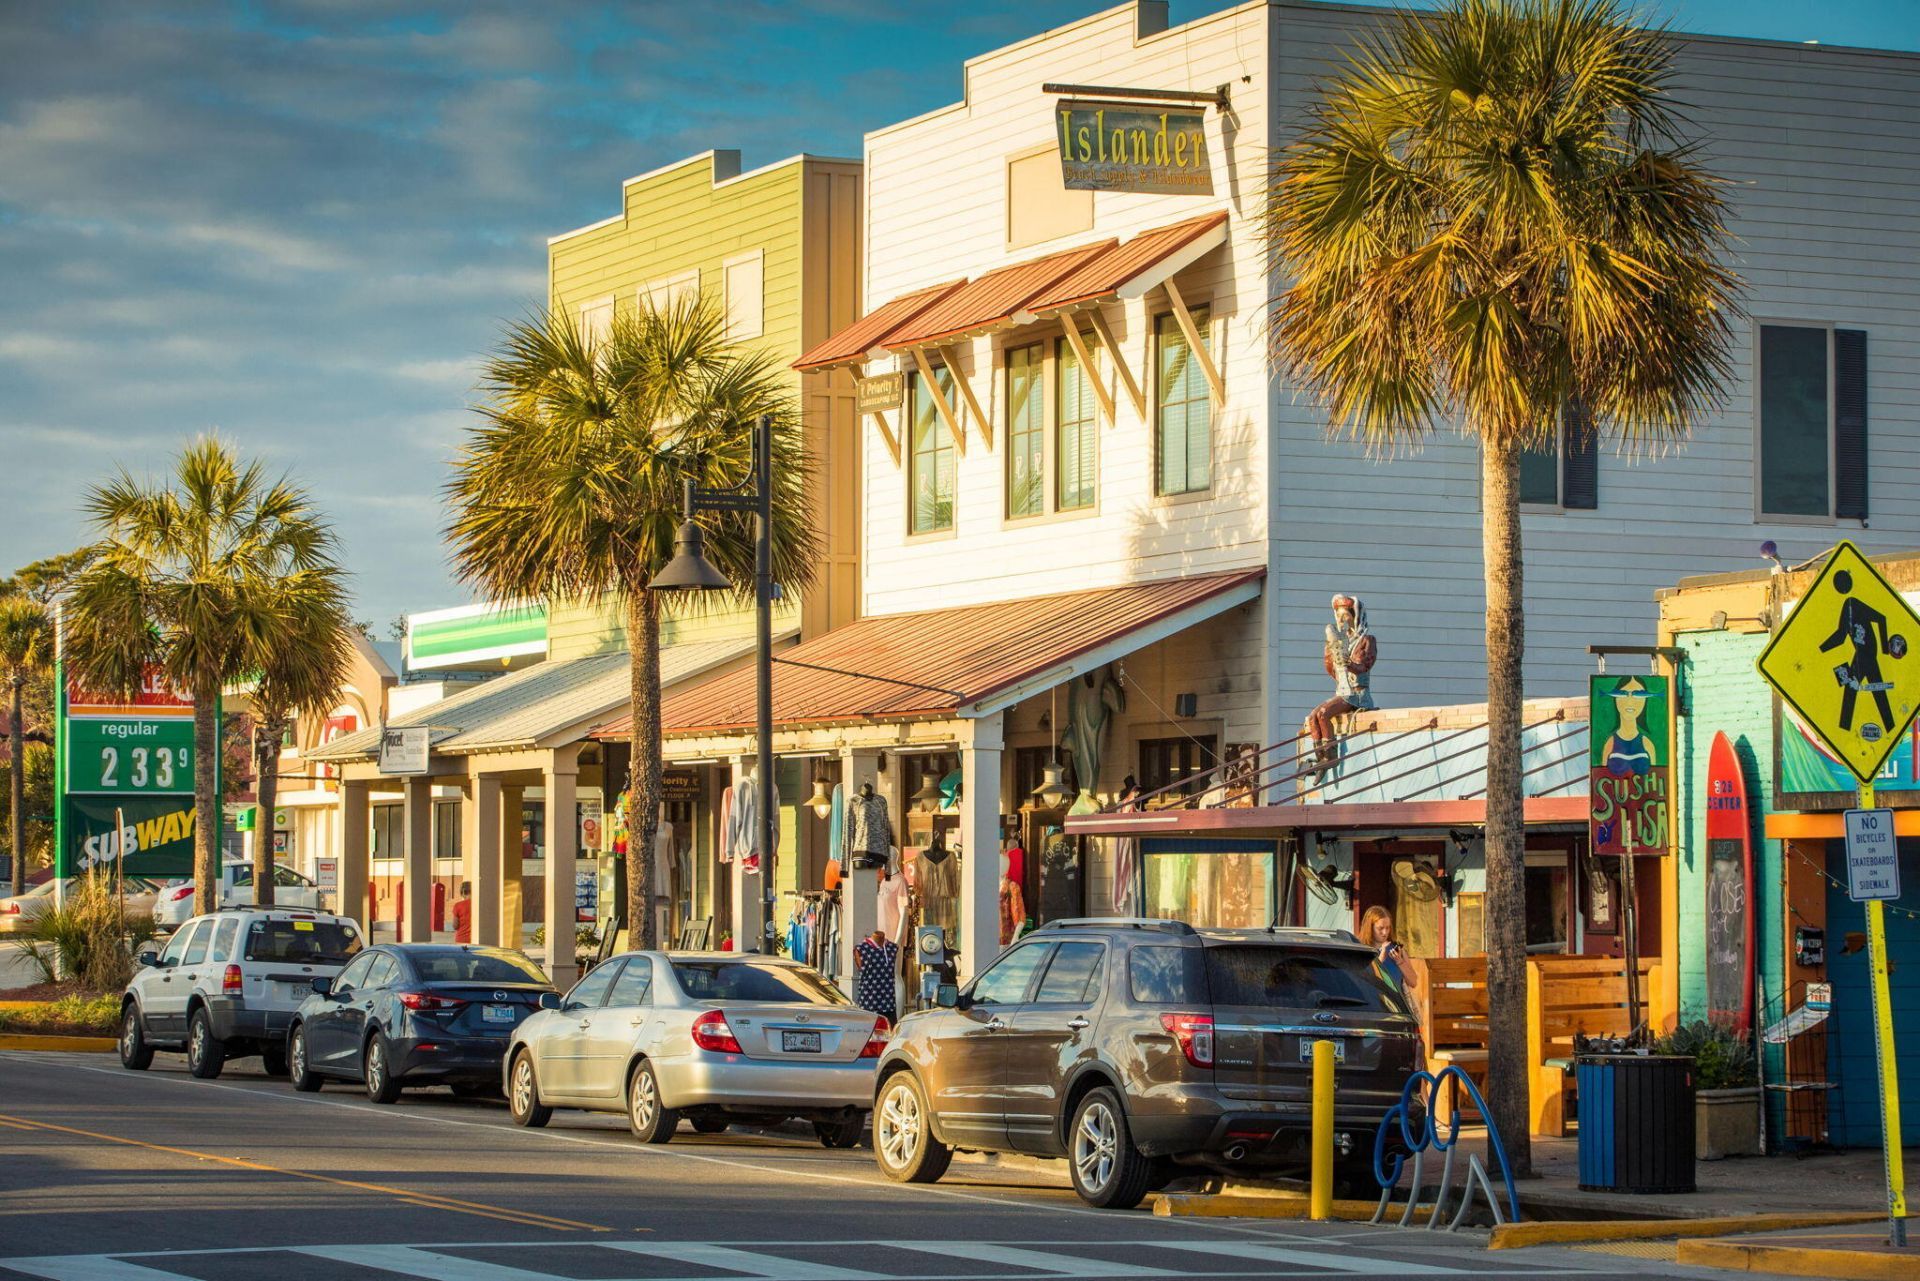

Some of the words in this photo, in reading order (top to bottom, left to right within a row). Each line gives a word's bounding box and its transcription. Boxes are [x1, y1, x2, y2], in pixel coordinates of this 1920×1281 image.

[1060, 109, 1205, 168] Islander
[101, 721, 159, 739] regular
[1592, 772, 1665, 822] SUSHI
[1707, 796, 1741, 810] CENTER
[1620, 799, 1669, 849] LISA
[1861, 817, 1878, 830] NO
[83, 807, 197, 866] SUBWAY
[1856, 832, 1887, 844] BICYCLES
[1851, 855, 1895, 868] SKATEBOARDS
[1859, 880, 1890, 890] SIDEWALK
